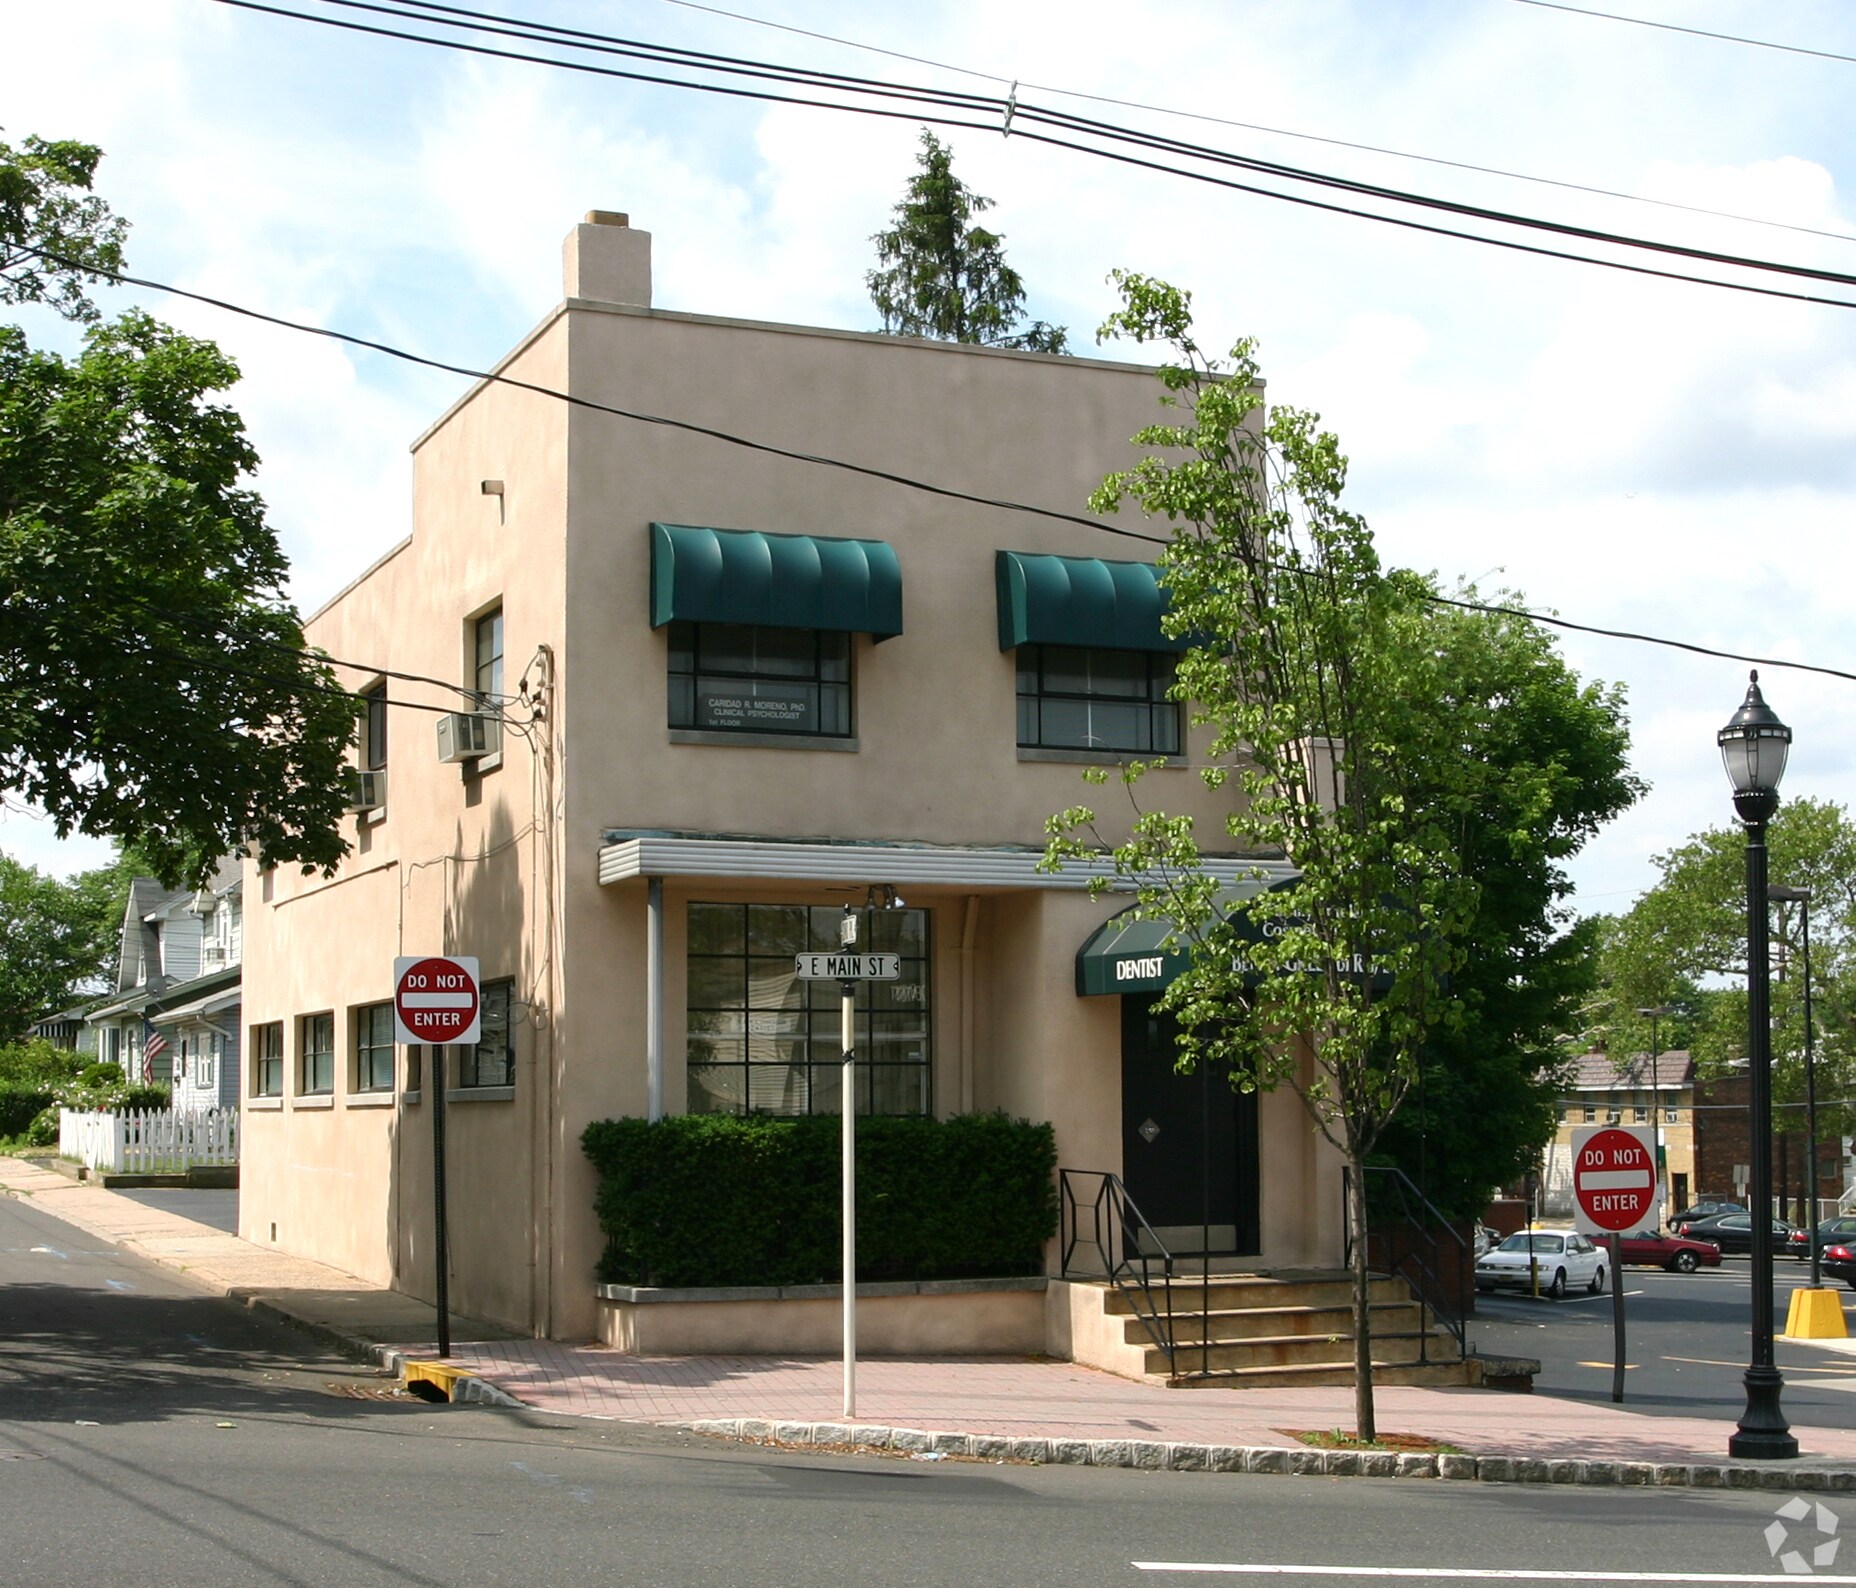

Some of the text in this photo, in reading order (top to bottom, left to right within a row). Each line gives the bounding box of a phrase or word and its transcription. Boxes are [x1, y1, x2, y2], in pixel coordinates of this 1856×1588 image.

[708, 698, 741, 709] CARIDAD
[713, 708, 800, 720] CLINICAL PSYCHOLOGIST
[811, 957, 884, 976] E MAIN ST
[1116, 956, 1164, 981] DENTIST
[407, 974, 466, 988] DO NOT
[414, 1012, 461, 1026] ENTER
[1585, 1148, 1642, 1166] DO NOT
[1593, 1194, 1639, 1212] ENTER
